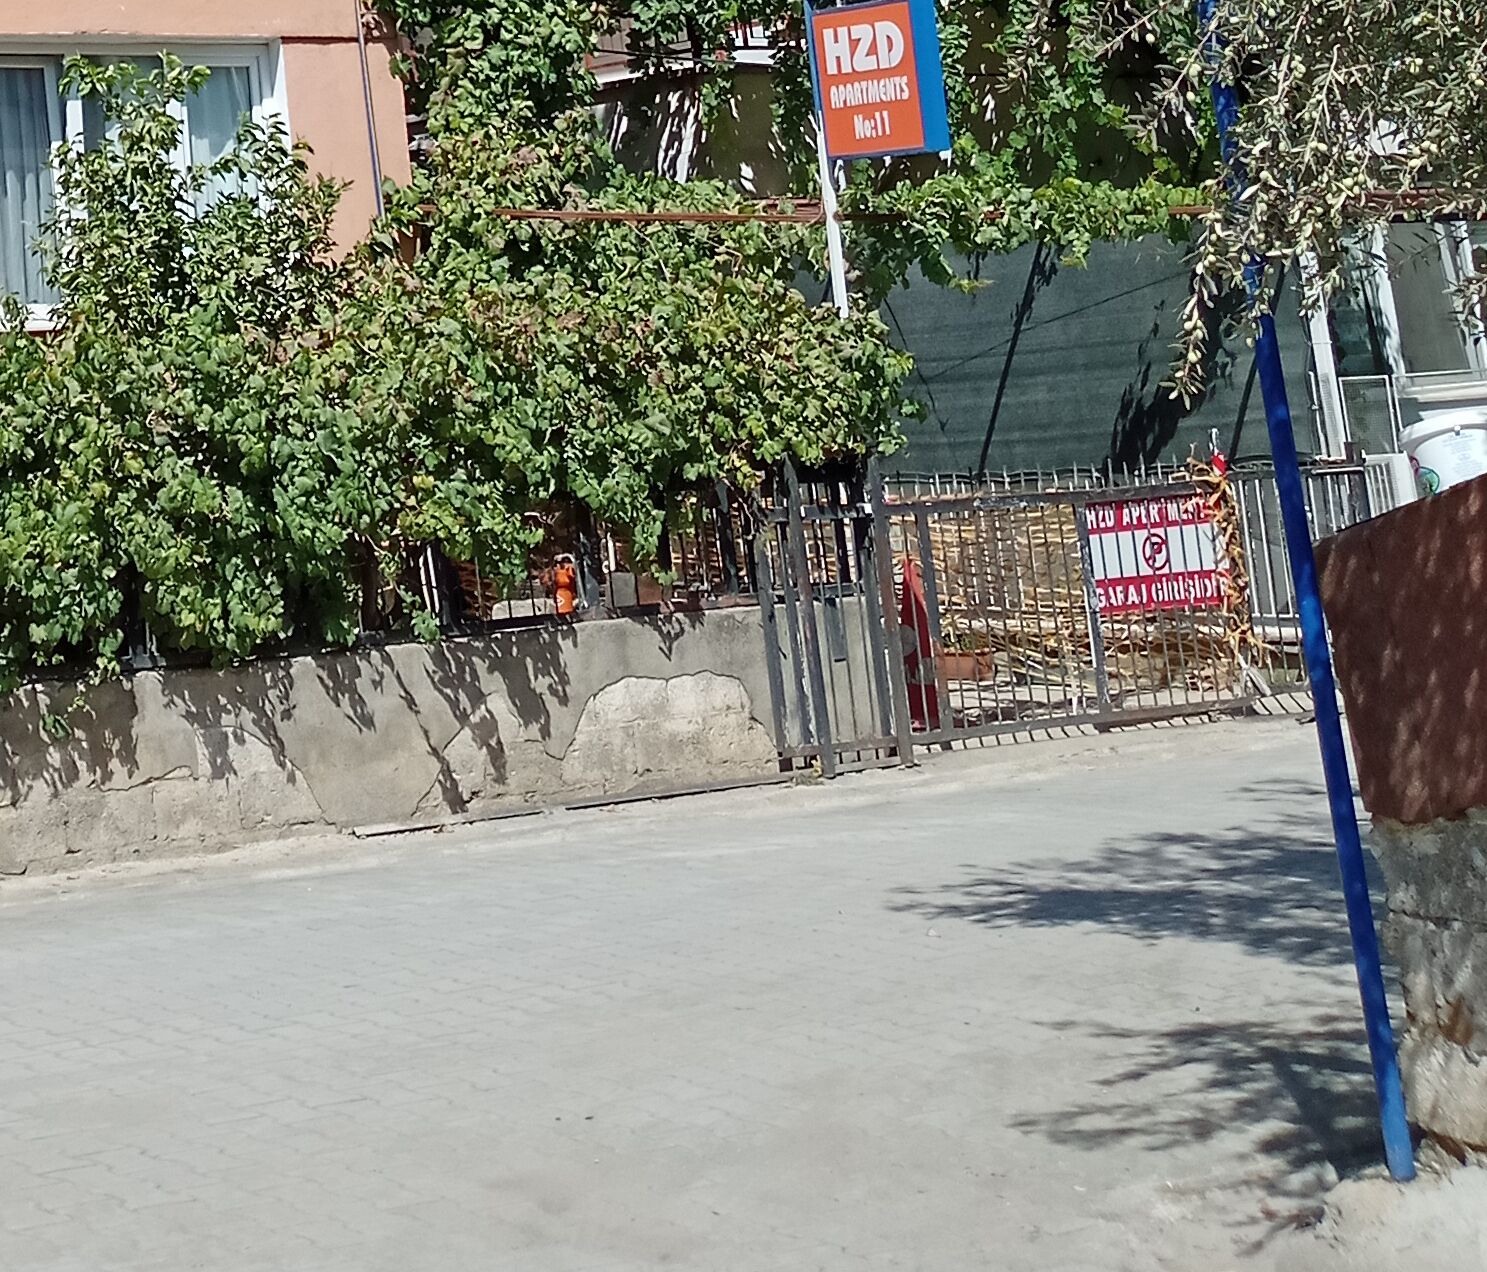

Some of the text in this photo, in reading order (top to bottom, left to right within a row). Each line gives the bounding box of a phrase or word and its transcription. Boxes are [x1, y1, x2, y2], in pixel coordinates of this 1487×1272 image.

[822, 21, 905, 75] HZD
[830, 75, 910, 109] APARTMENTS
[853, 110, 891, 140] No:11
